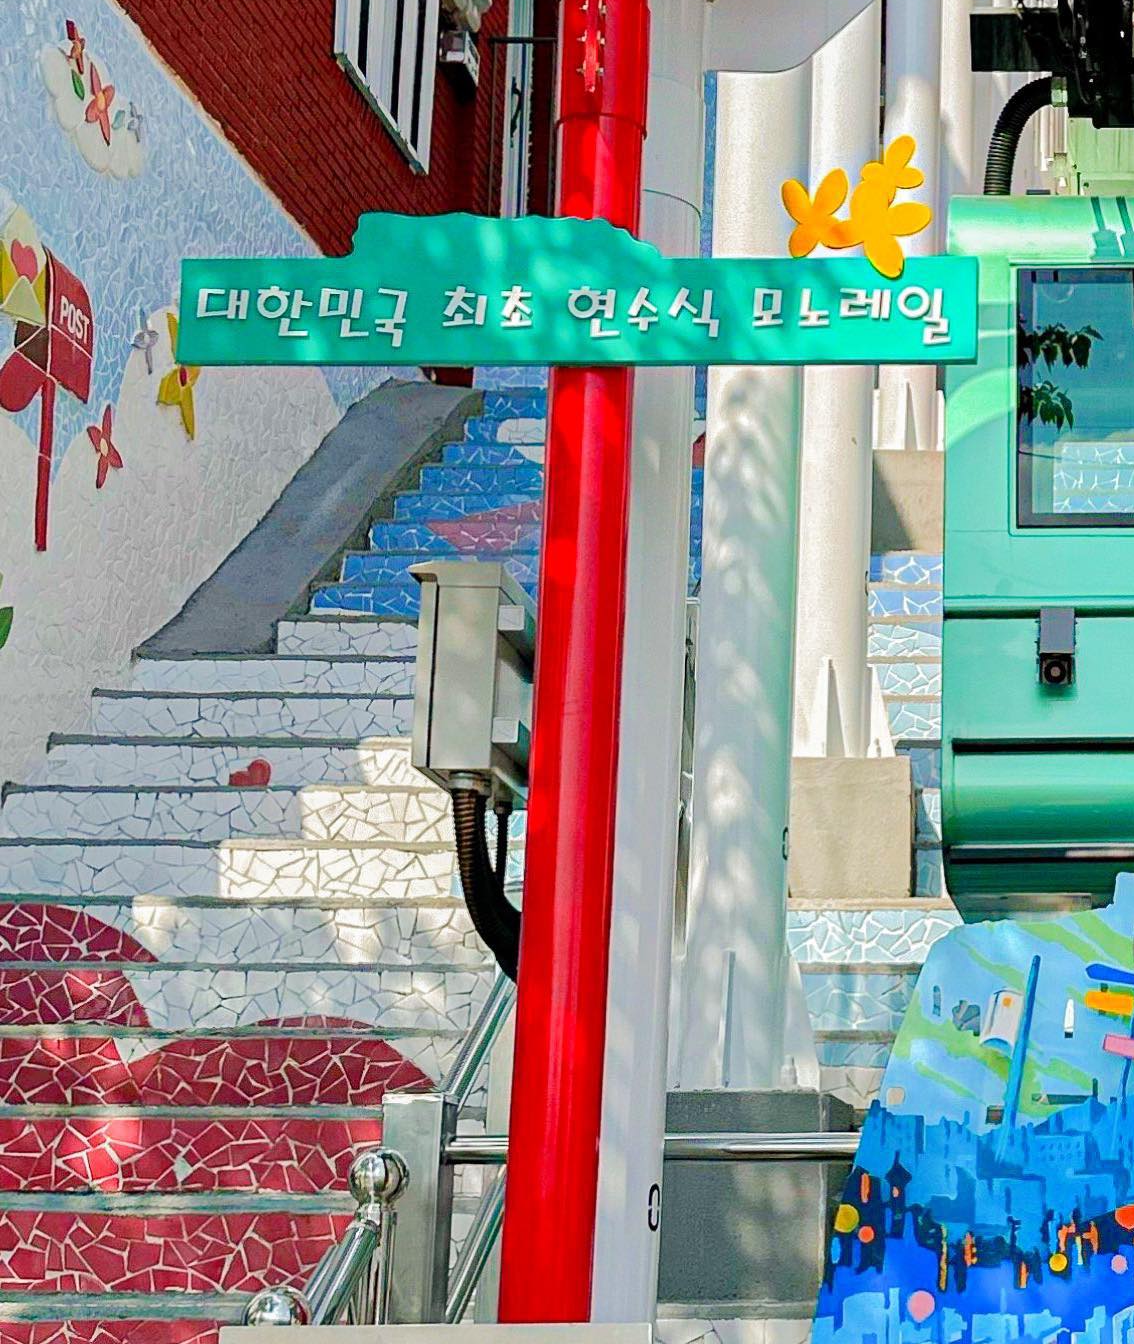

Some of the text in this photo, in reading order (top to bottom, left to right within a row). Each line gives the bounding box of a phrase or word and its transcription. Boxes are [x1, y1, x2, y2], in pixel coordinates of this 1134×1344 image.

[60, 295, 90, 345] POST
[195, 284, 950, 348] 대한민국 최초 현수식 모노레일
